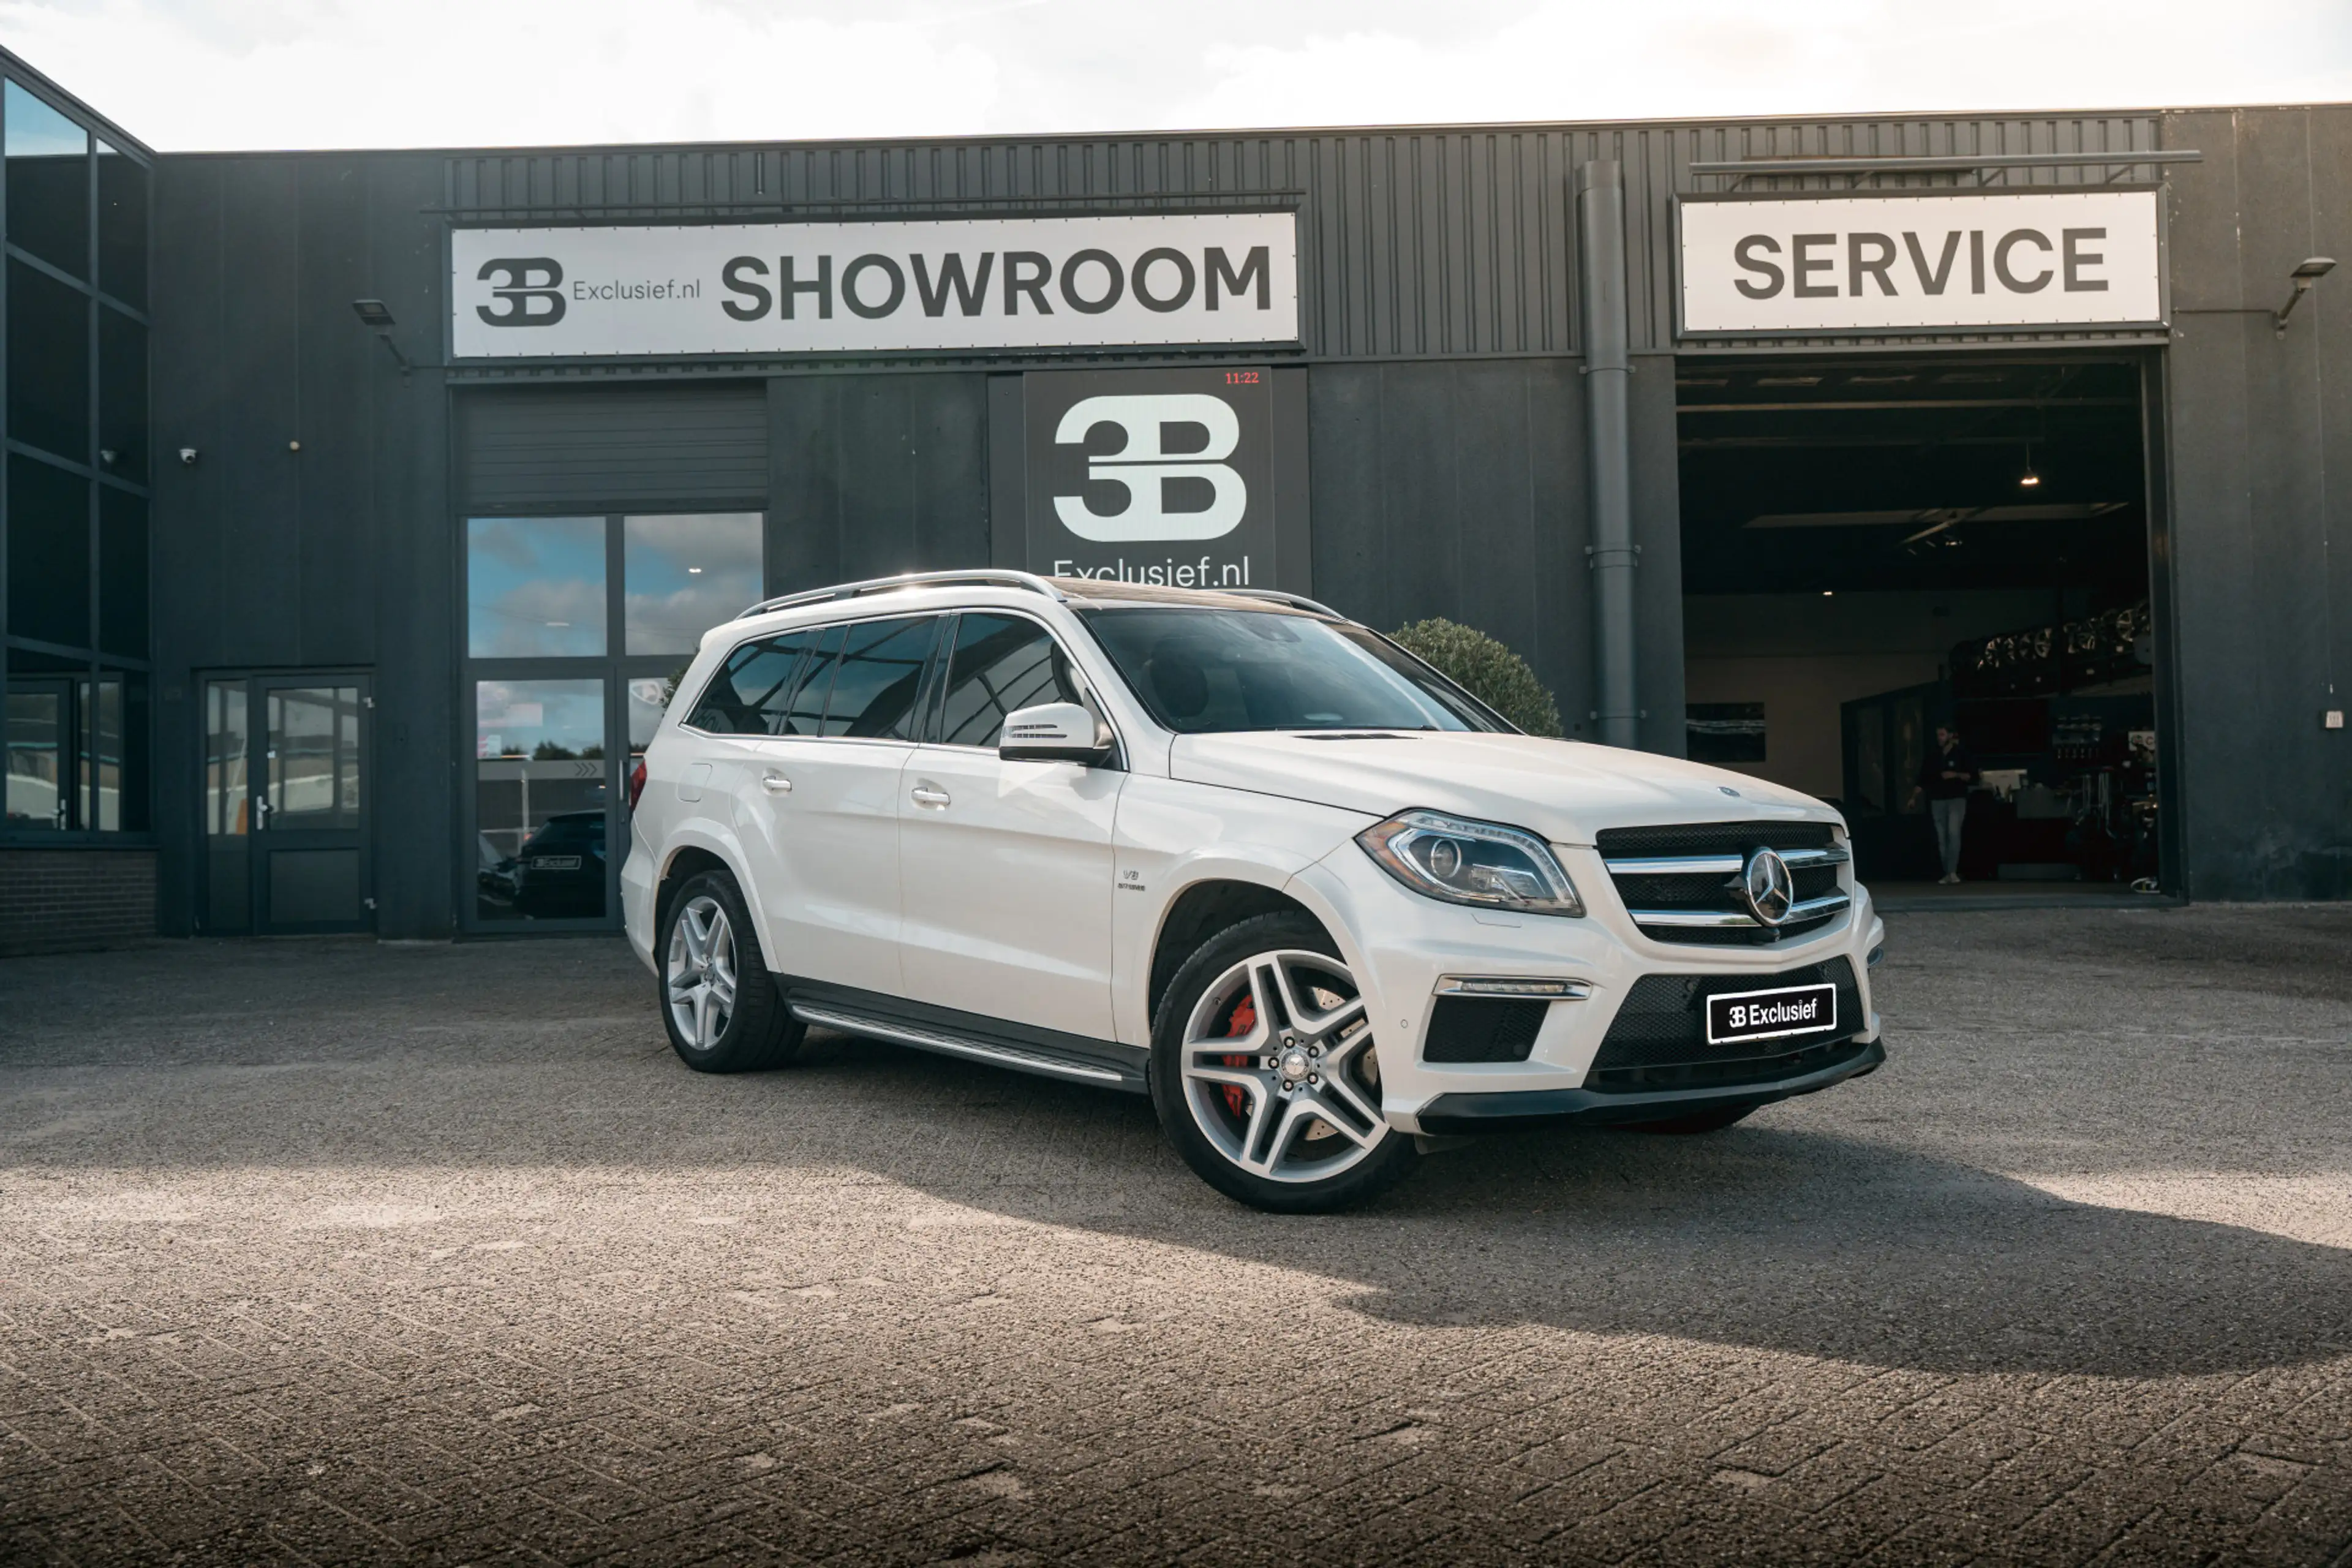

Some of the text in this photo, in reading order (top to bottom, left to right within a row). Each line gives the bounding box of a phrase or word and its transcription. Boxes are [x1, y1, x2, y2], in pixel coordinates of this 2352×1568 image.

[476, 246, 1271, 327] 3B Exclusief.nl SHOWROOM
[1733, 227, 2109, 300] SERVICE
[1225, 372, 1259, 384] 11:22
[1053, 394, 1247, 542] 3B
[1054, 556, 1249, 586] Exclusief.nl
[1729, 997, 1818, 1028] 3B Exclusief
